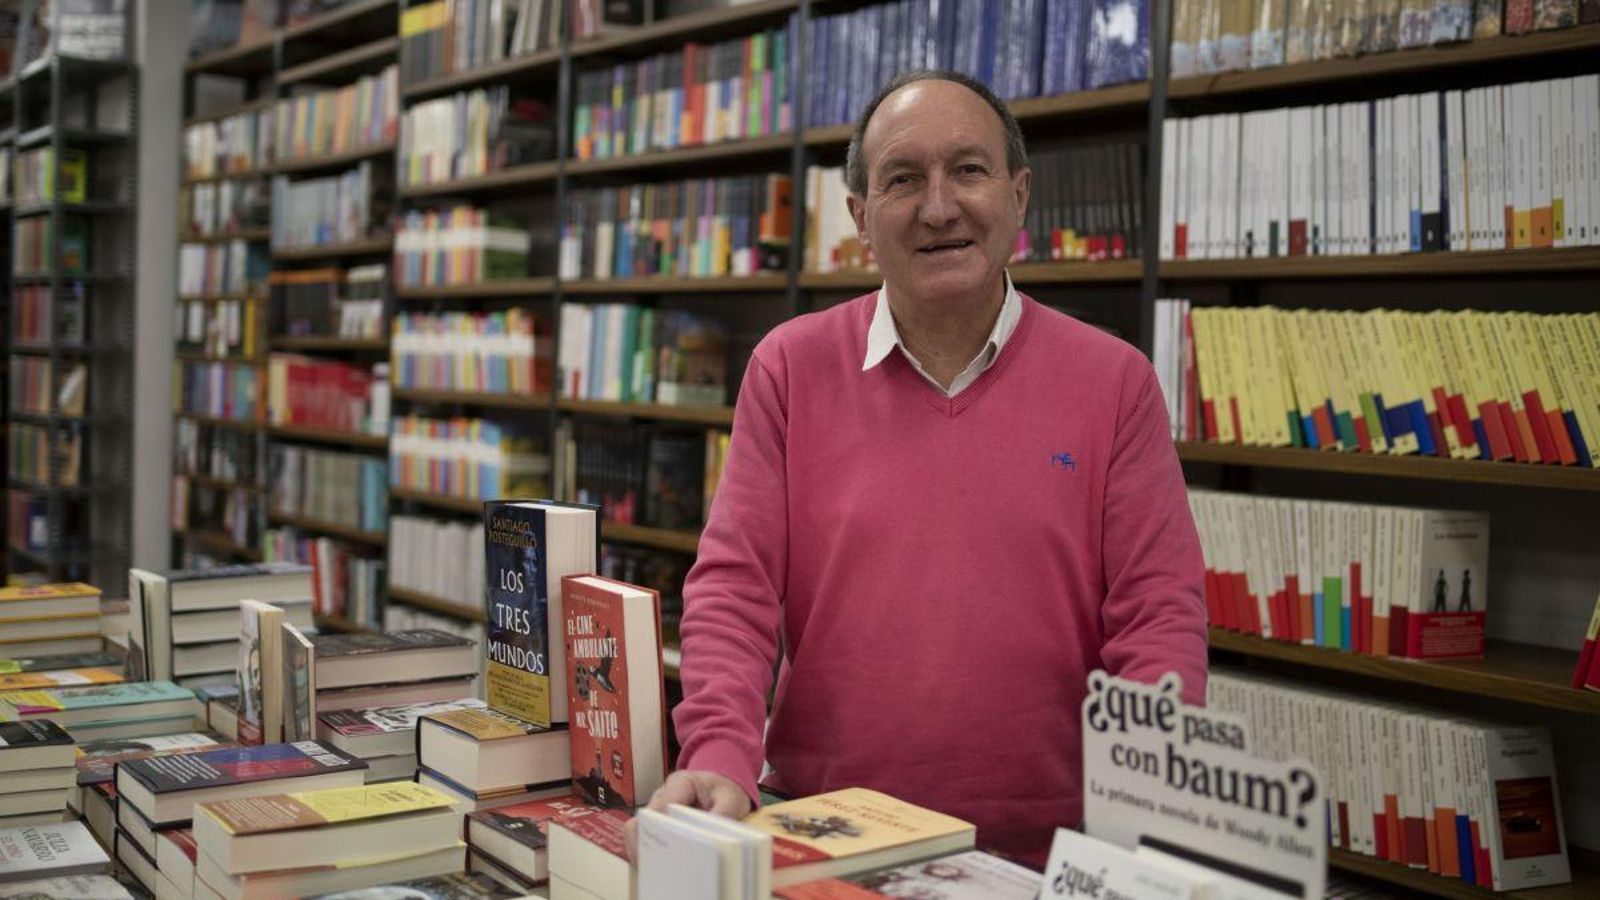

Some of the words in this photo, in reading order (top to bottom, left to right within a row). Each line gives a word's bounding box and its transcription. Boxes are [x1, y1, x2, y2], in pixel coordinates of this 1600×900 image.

[492, 516, 530, 534] SANTIAGO
[500, 568, 524, 594] LOS
[495, 602, 531, 635] TRES
[576, 614, 594, 635] CINE
[487, 643, 544, 675] MUNDOS
[573, 637, 618, 659] AMBULANTE
[589, 689, 598, 706] DE
[587, 709, 619, 739] SAITO
[1087, 678, 1175, 733] ¿qué
[1182, 713, 1245, 751] pasa
[1110, 740, 1159, 777] con
[1164, 742, 1316, 830] baum?
[1090, 779, 1106, 797] La
[1107, 785, 1155, 813] primera
[1158, 802, 1200, 826] novela
[1204, 812, 1219, 830] de
[1223, 815, 1271, 847] Woody
[1277, 832, 1316, 859] Allen
